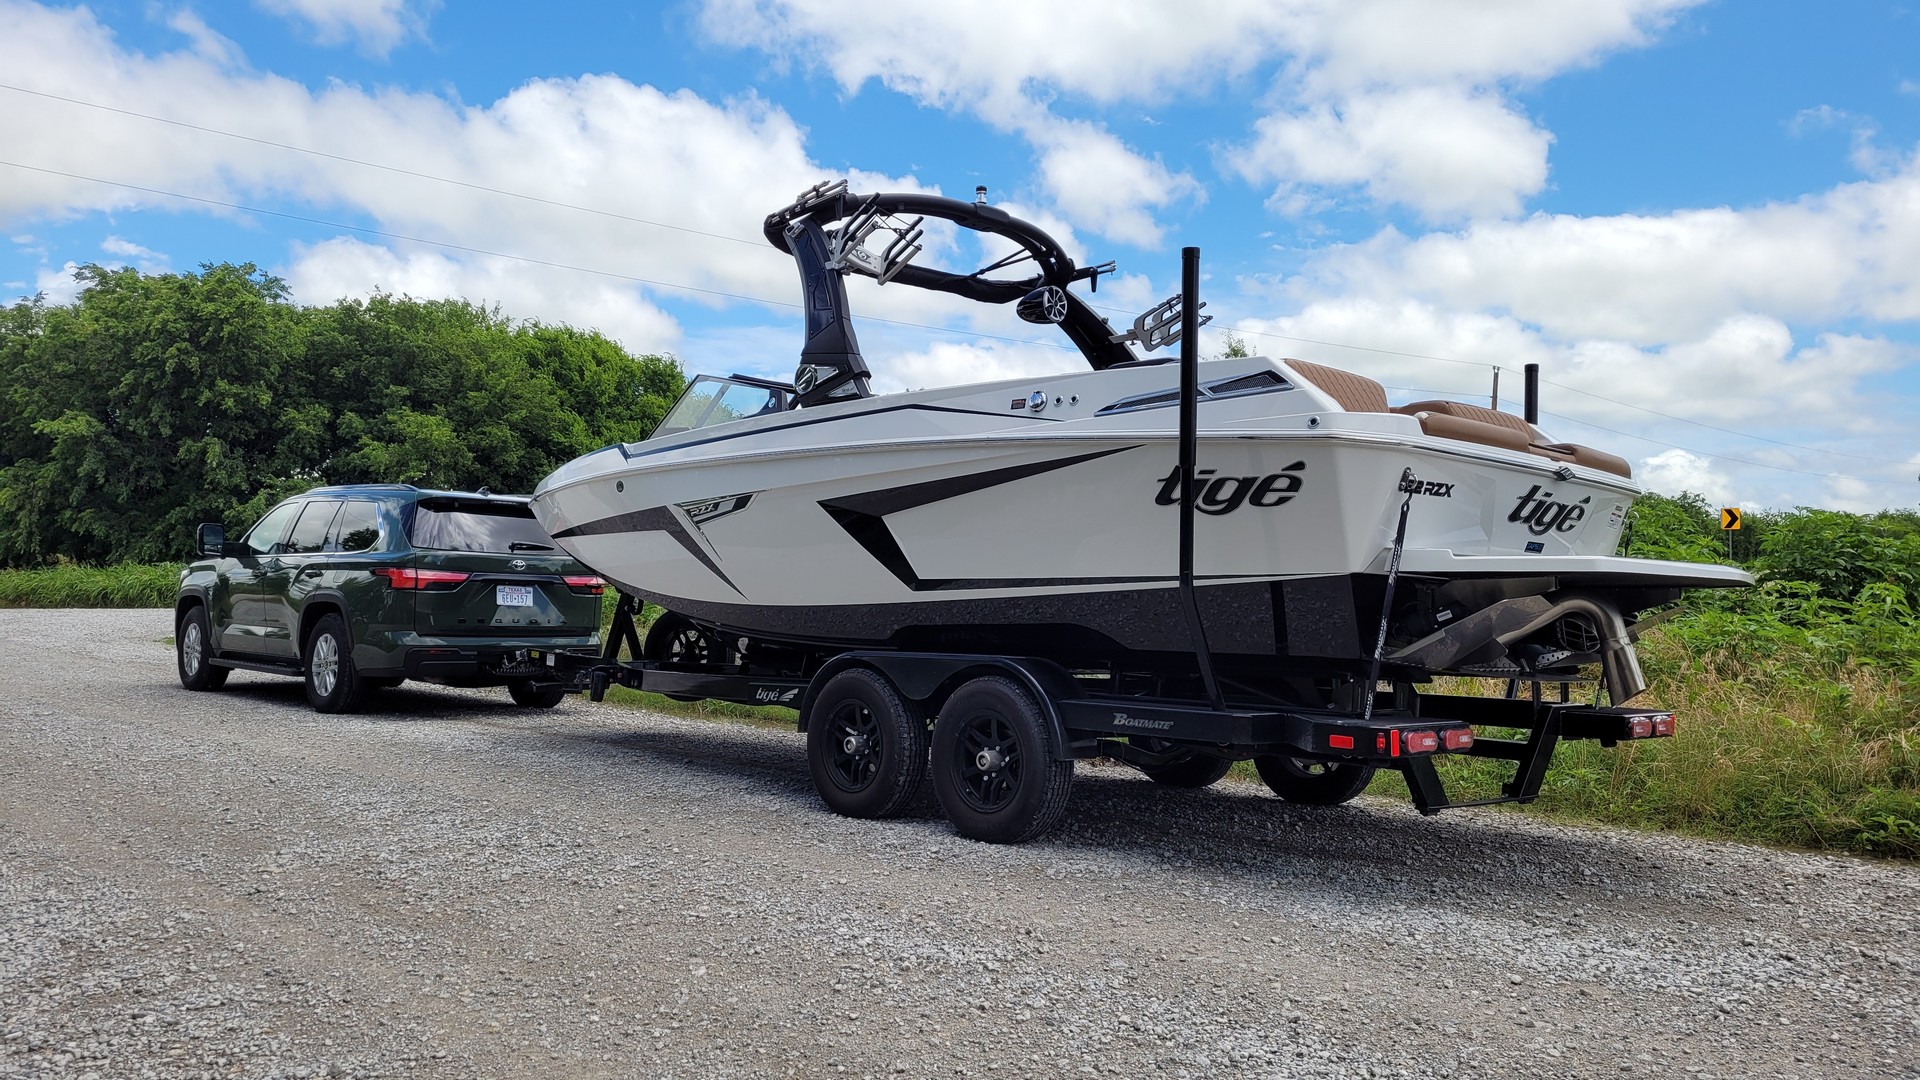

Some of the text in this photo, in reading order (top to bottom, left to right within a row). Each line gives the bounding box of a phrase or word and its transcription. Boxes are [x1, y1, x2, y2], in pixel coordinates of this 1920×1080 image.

[690, 503, 716, 517] RZX
[1507, 484, 1592, 536] tigé
[756, 687, 780, 702] tigé
